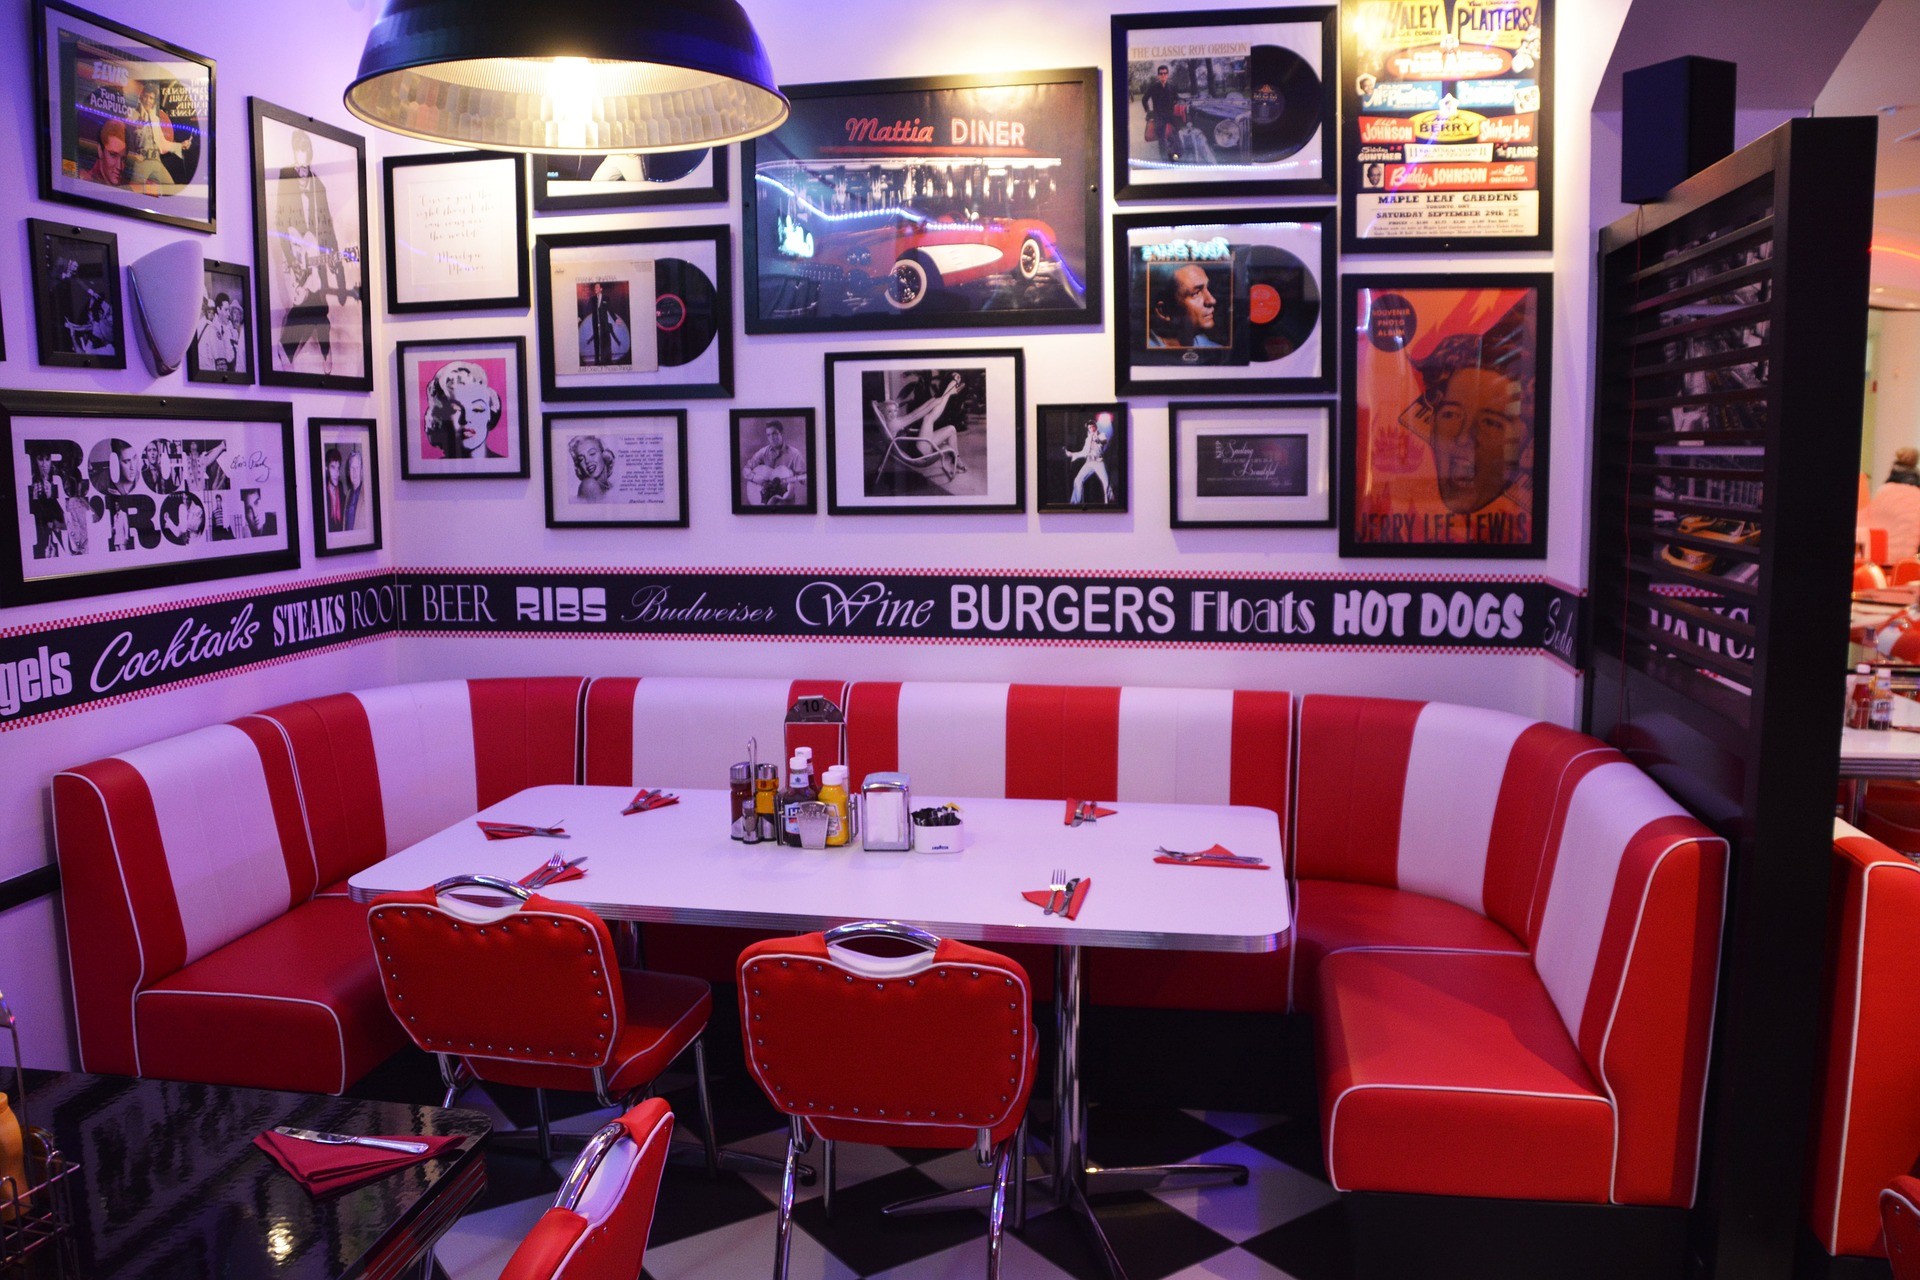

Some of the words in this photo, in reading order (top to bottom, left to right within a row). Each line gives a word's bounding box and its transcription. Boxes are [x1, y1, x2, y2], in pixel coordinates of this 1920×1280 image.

[1458, 8, 1531, 32] PLATTERS
[1132, 47, 1149, 58] THE
[1151, 45, 1187, 58] CLASSIC
[1189, 44, 1206, 56] ROY
[1208, 42, 1248, 55] ORBISON
[92, 60, 130, 87] ELVIS
[846, 117, 934, 143] Mattia
[951, 118, 1025, 146] DINER
[1363, 123, 1413, 141] JOHNSON
[1420, 123, 1474, 132] BERRY
[1428, 167, 1487, 186] JOHNSON
[1378, 195, 1419, 205] MAPLE
[1427, 194, 1455, 203] LEAF
[1463, 193, 1518, 203] GARDENS
[1376, 211, 1423, 219] SATURDAY
[1428, 210, 1481, 218] SEPTEMBER
[1371, 308, 1411, 317] SOUVENIR
[1377, 318, 1406, 327] PHOTO
[24, 437, 231, 499] ROCK
[1355, 511, 1415, 543] JERRY
[1424, 512, 1455, 543] LEE
[1465, 511, 1528, 544] LEWIS
[90, 602, 261, 693] Cocktails
[272, 590, 346, 648] STEAKS
[351, 584, 411, 630] ROOT
[422, 584, 497, 622] BEER
[515, 586, 607, 622] RIBS
[620, 584, 777, 624] Budweiser
[795, 581, 935, 629] Wine
[950, 583, 1176, 634] BURGERS
[1190, 589, 1316, 634] Floats
[1332, 589, 1413, 638] HOT
[1420, 591, 1525, 640] DOGS
[803, 699, 820, 713] 10
